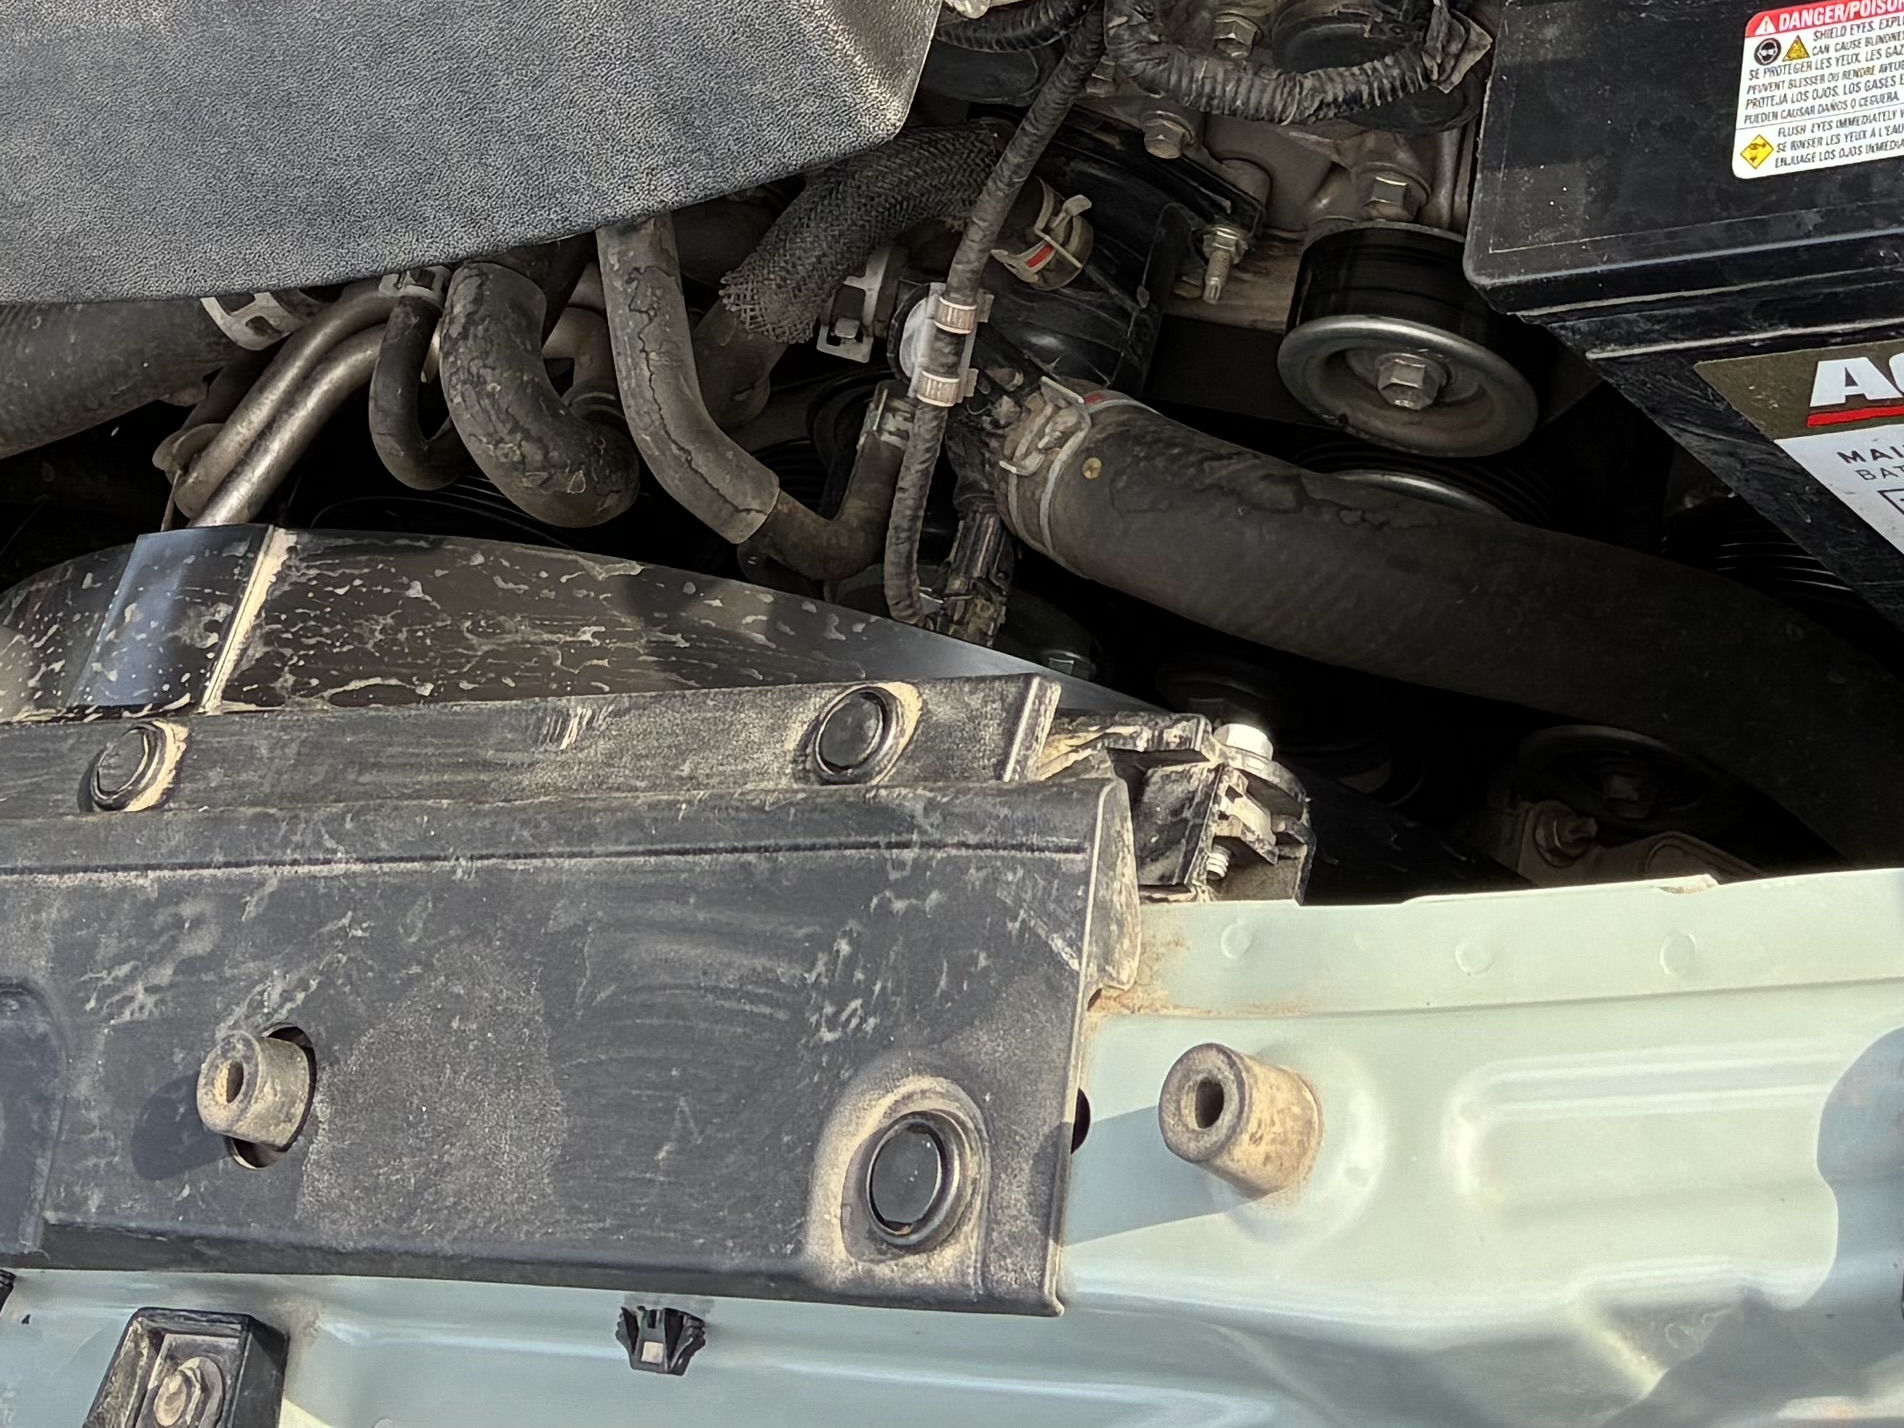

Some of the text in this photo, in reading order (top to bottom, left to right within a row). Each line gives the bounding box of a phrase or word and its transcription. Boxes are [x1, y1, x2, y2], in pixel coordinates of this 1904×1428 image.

[1812, 25, 1846, 41] SHIELD
[1815, 56, 1832, 70] LES
[1865, 48, 1883, 61] LES
[1885, 44, 1904, 58] GAZ
[1790, 89, 1809, 103] LOS
[1842, 80, 1862, 95] LOS
[1863, 75, 1897, 91] GASES
